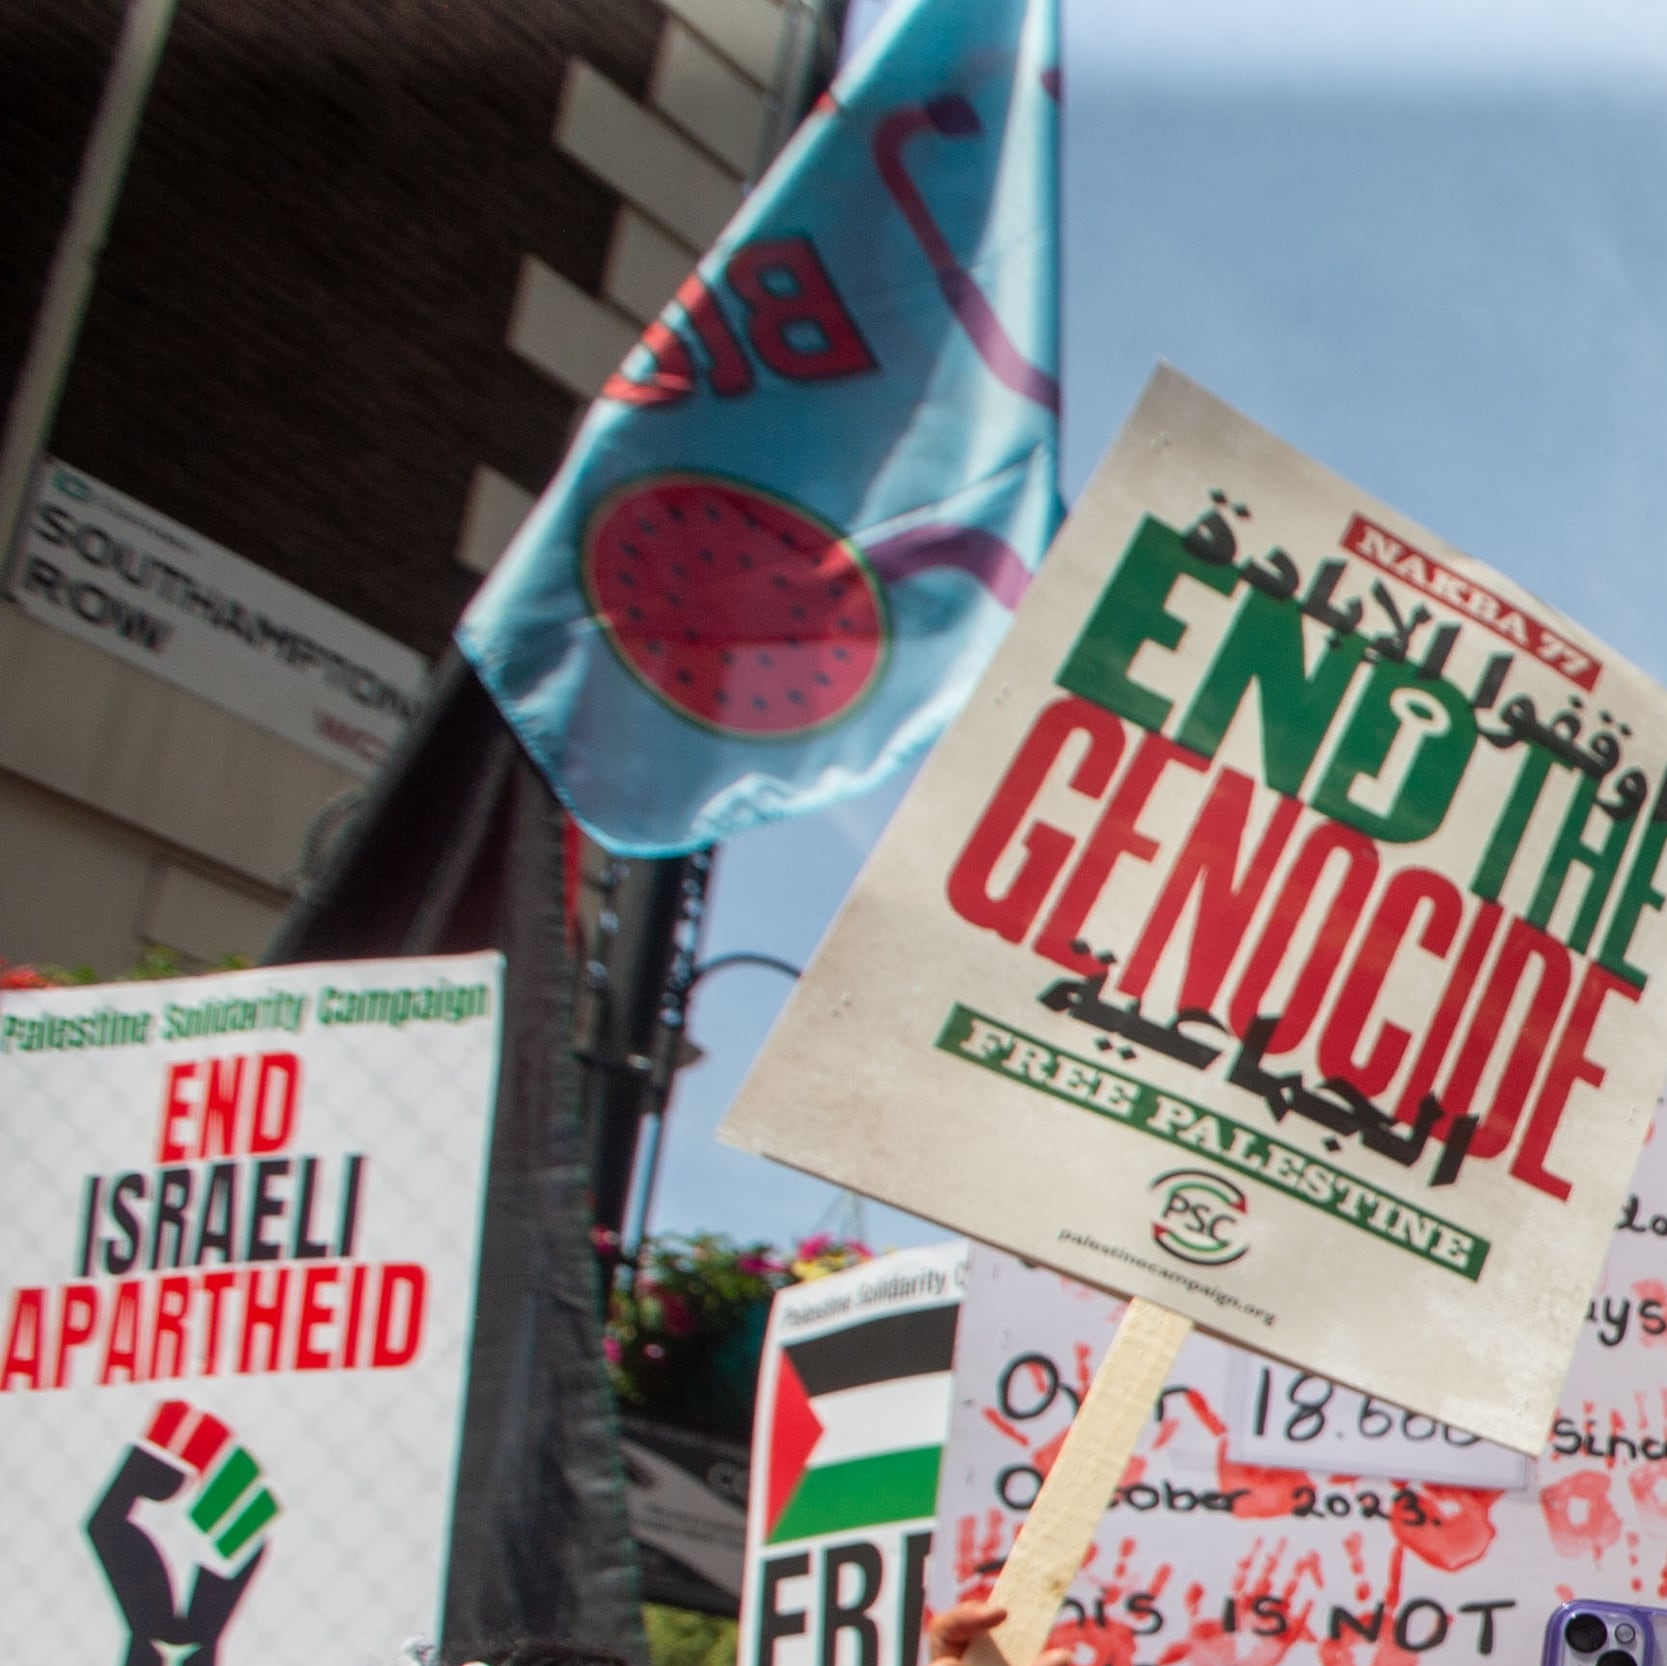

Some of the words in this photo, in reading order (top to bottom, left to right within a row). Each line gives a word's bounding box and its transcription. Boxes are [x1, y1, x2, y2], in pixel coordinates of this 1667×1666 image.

[23, 558, 174, 656] ROW
[36, 502, 418, 722] SOUTHAMPTON
[1355, 525, 1533, 646] NAKBA
[1536, 634, 1590, 678] 77
[1054, 513, 1478, 844] END
[162, 989, 308, 1041] Solidarity
[315, 978, 489, 1030] Campaign
[946, 696, 1644, 1201] GENOCIDE
[156, 1052, 304, 1164] END
[960, 1020, 1140, 1117] FREE
[1147, 1095, 1476, 1268] PALESTINE
[79, 1154, 366, 1278] ISRAELI
[1056, 1228, 1278, 1327] palestinecampaign.org
[1162, 1192, 1243, 1245] PSC
[0, 1262, 427, 1392] APARTHEID
[1329, 1597, 1517, 1656] NOT
